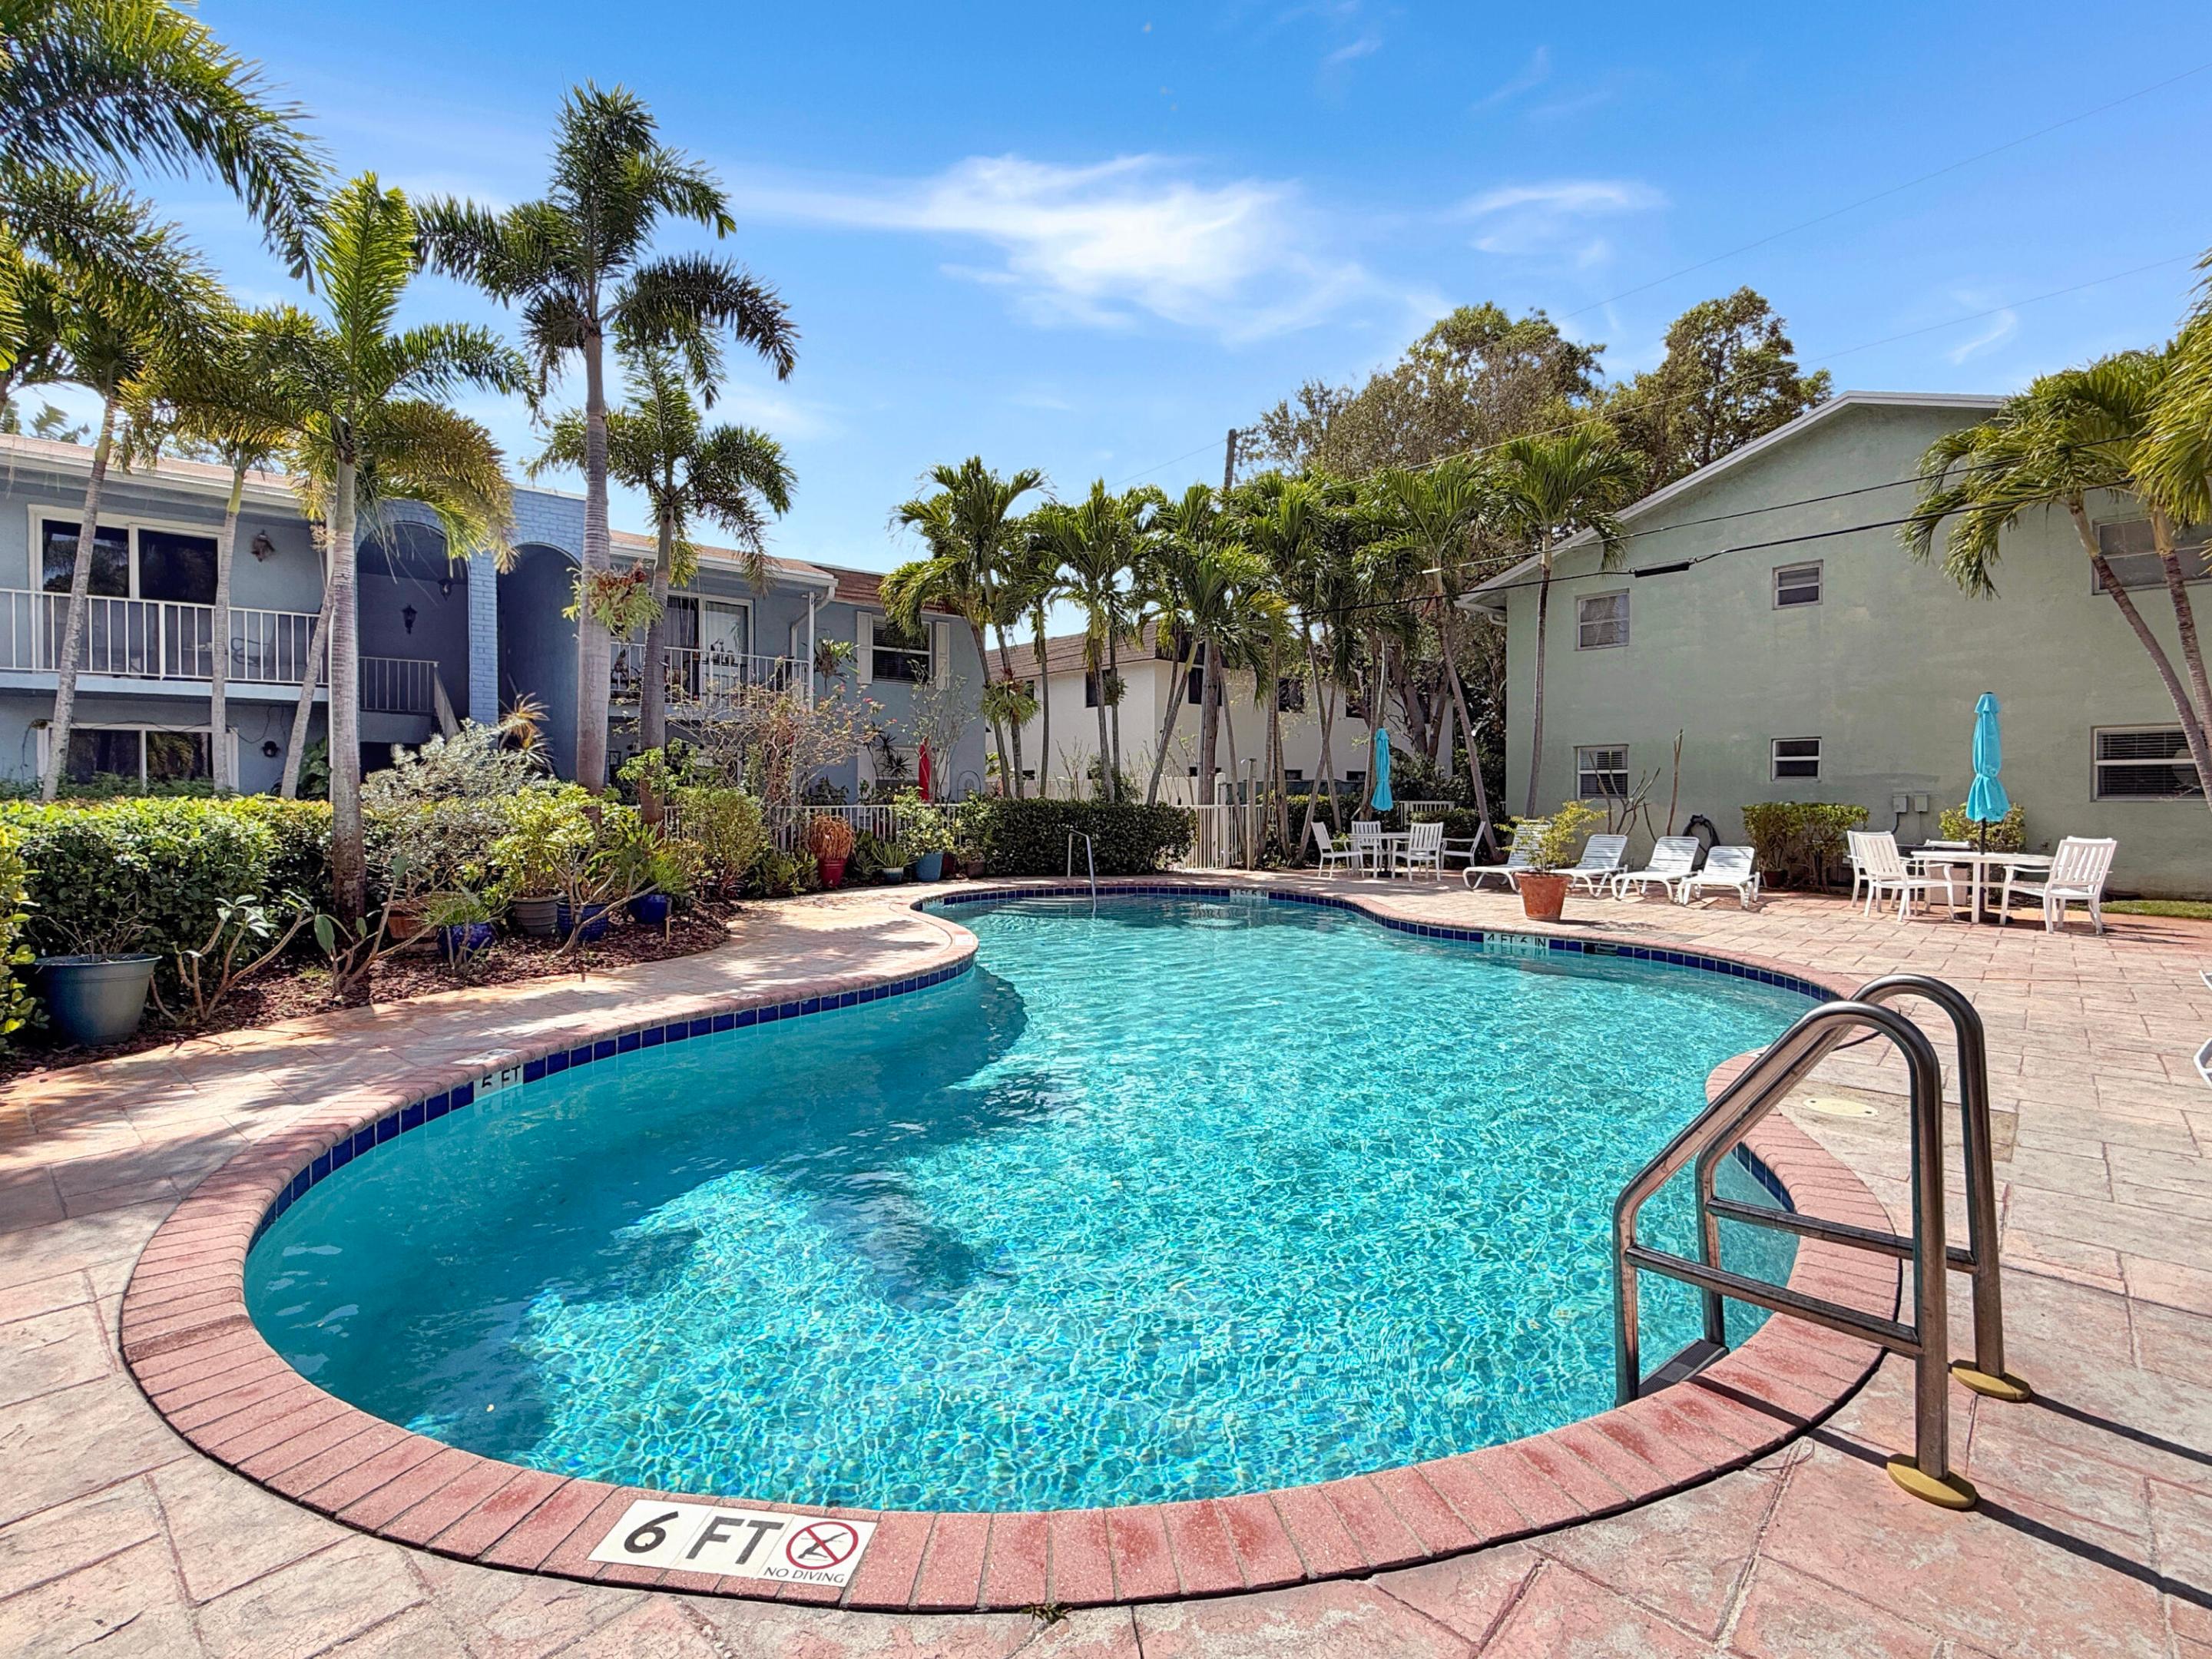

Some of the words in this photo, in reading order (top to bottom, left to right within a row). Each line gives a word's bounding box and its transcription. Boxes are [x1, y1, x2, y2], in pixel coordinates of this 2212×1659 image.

[1500, 934, 1515, 944] FT
[1535, 937, 1546, 947] IN
[501, 1065, 522, 1088] FT
[624, 1511, 679, 1554] 6
[685, 1515, 785, 1565] FT
[763, 1567, 790, 1578] NO
[791, 1569, 845, 1584] DIVING
